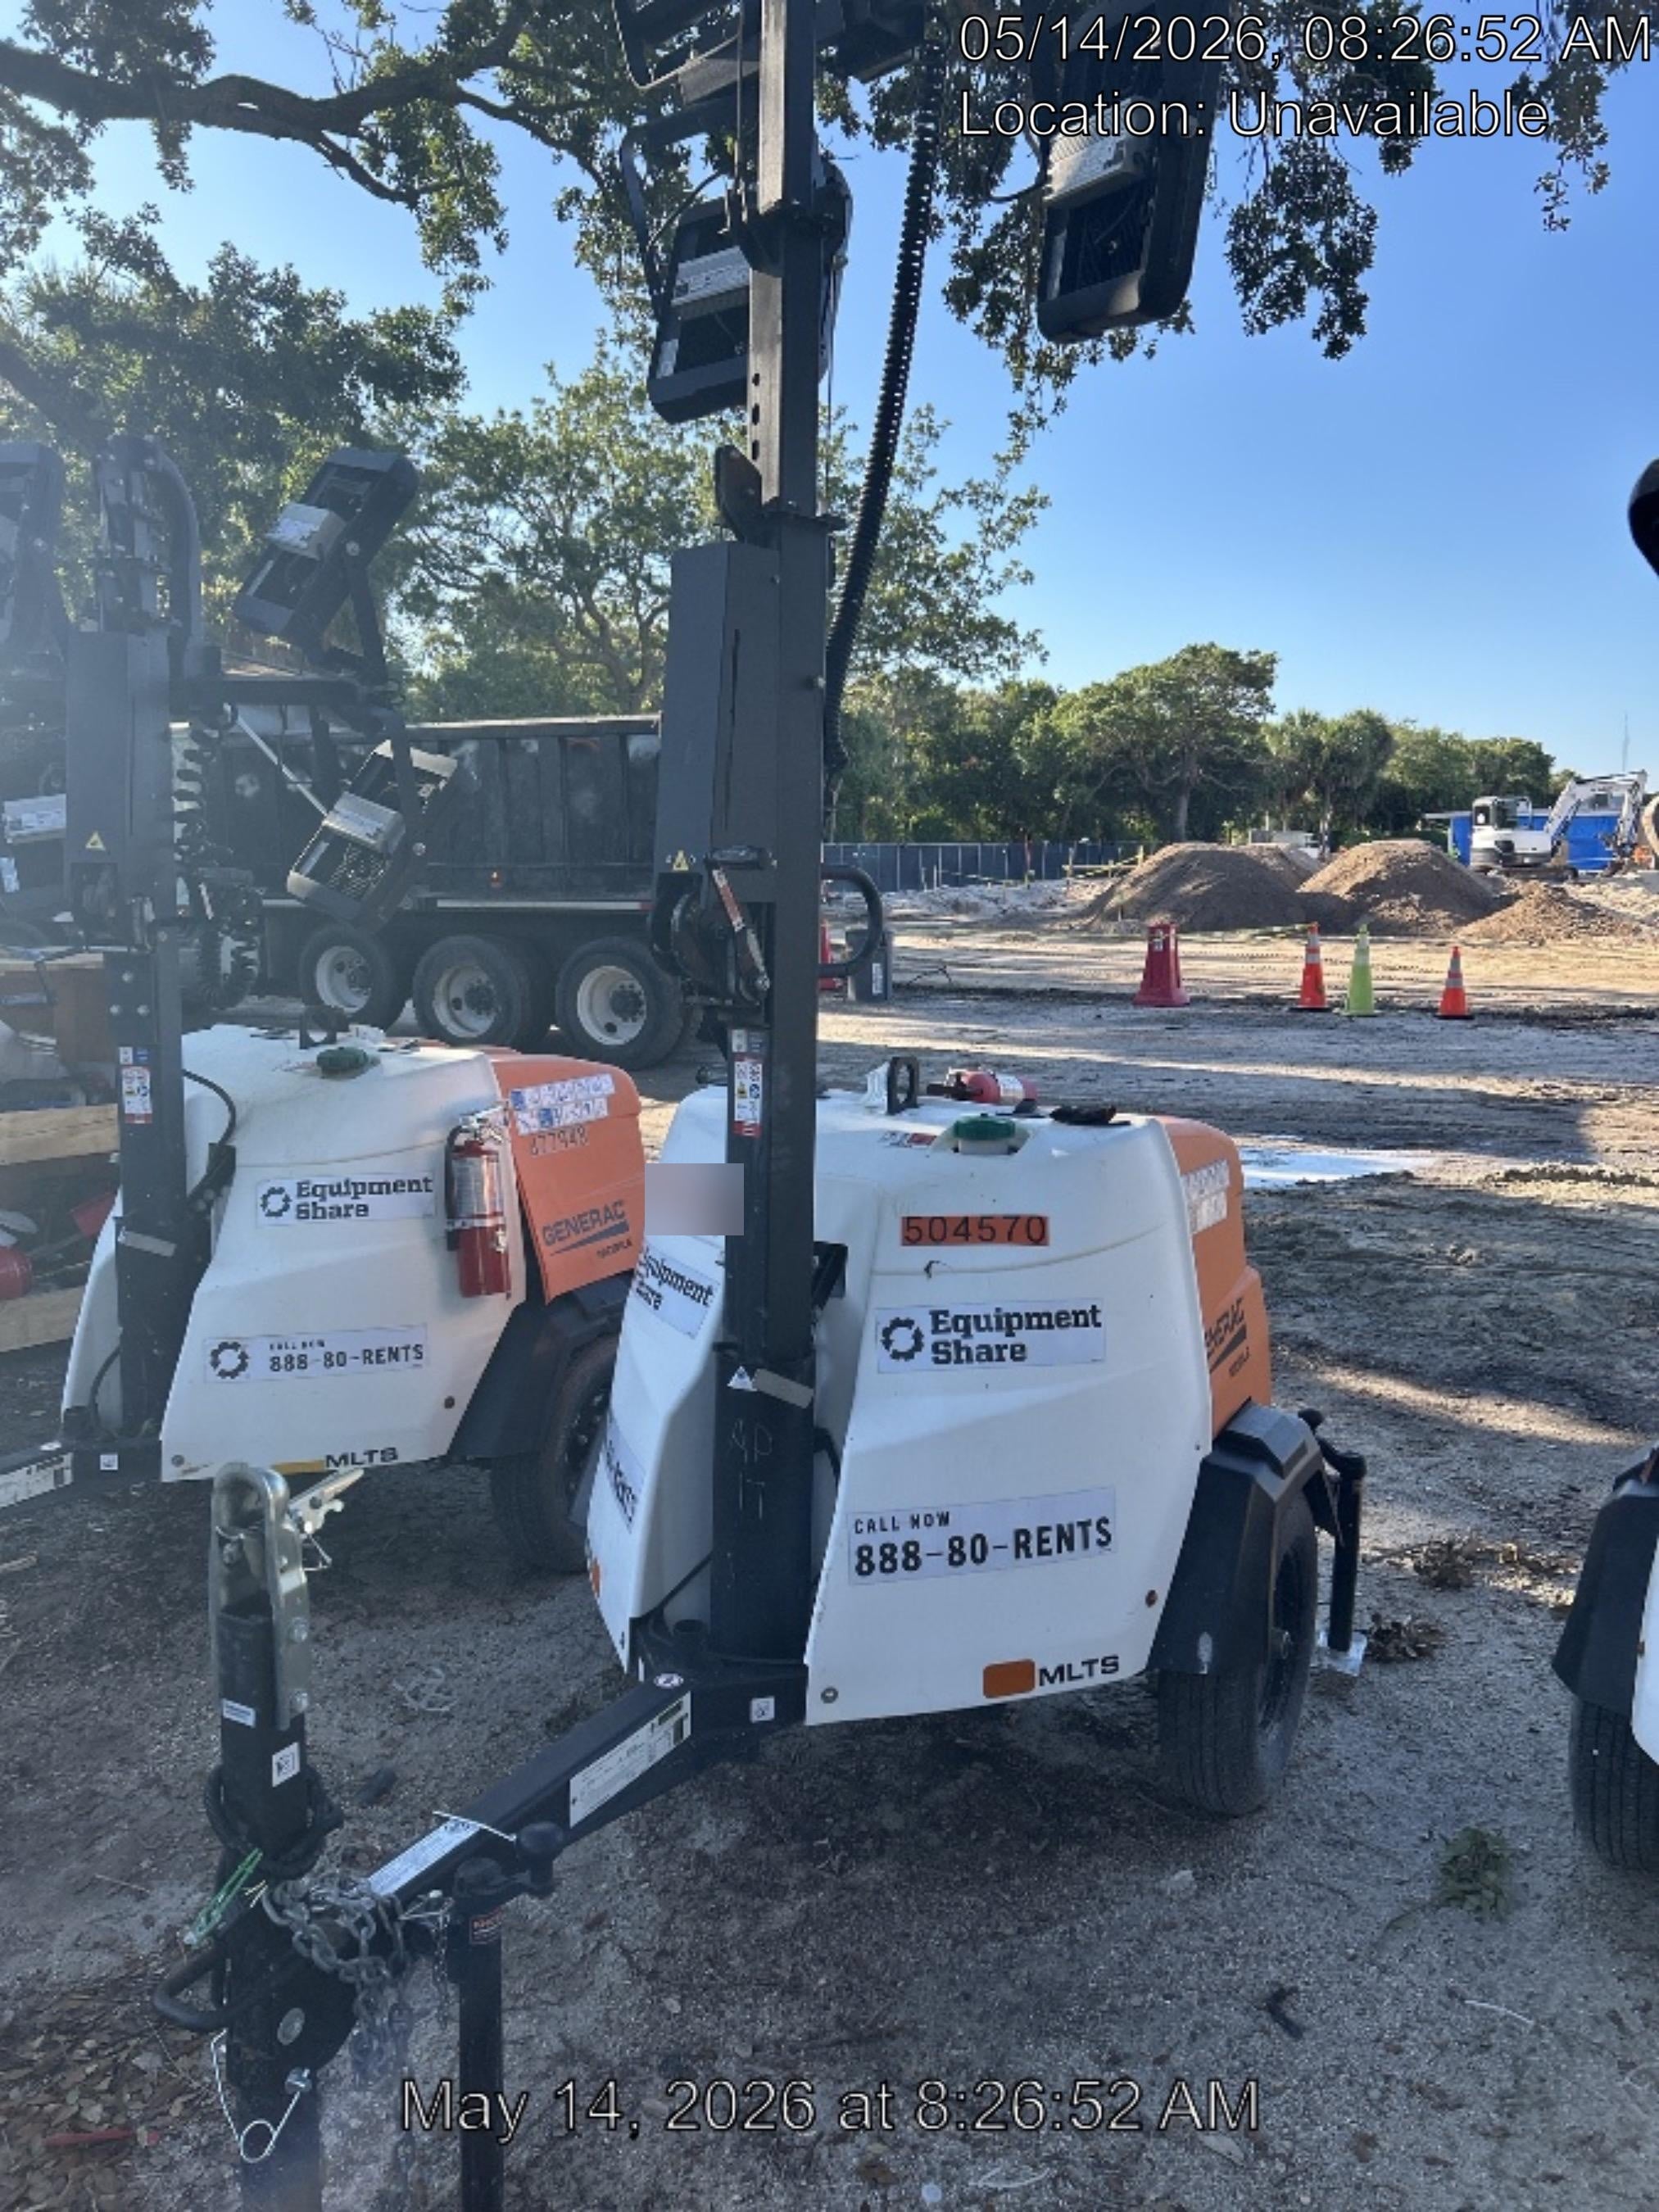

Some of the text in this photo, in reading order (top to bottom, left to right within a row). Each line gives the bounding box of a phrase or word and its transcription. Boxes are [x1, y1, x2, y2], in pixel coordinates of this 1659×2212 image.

[297, 1176, 433, 1201] Equipment
[296, 1202, 369, 1220] Share
[542, 1199, 626, 1246] GENERAC
[904, 1216, 1046, 1244] 504570
[929, 1304, 1102, 1339] Equipment
[270, 1344, 424, 1372] 888-80-RENTS
[931, 1339, 1027, 1365] Share
[325, 1447, 399, 1468] MLTS
[854, 1511, 950, 1534] CALL NOW
[854, 1516, 1112, 1576] 888-80-RENTS
[1038, 1654, 1119, 1686] MLTS
